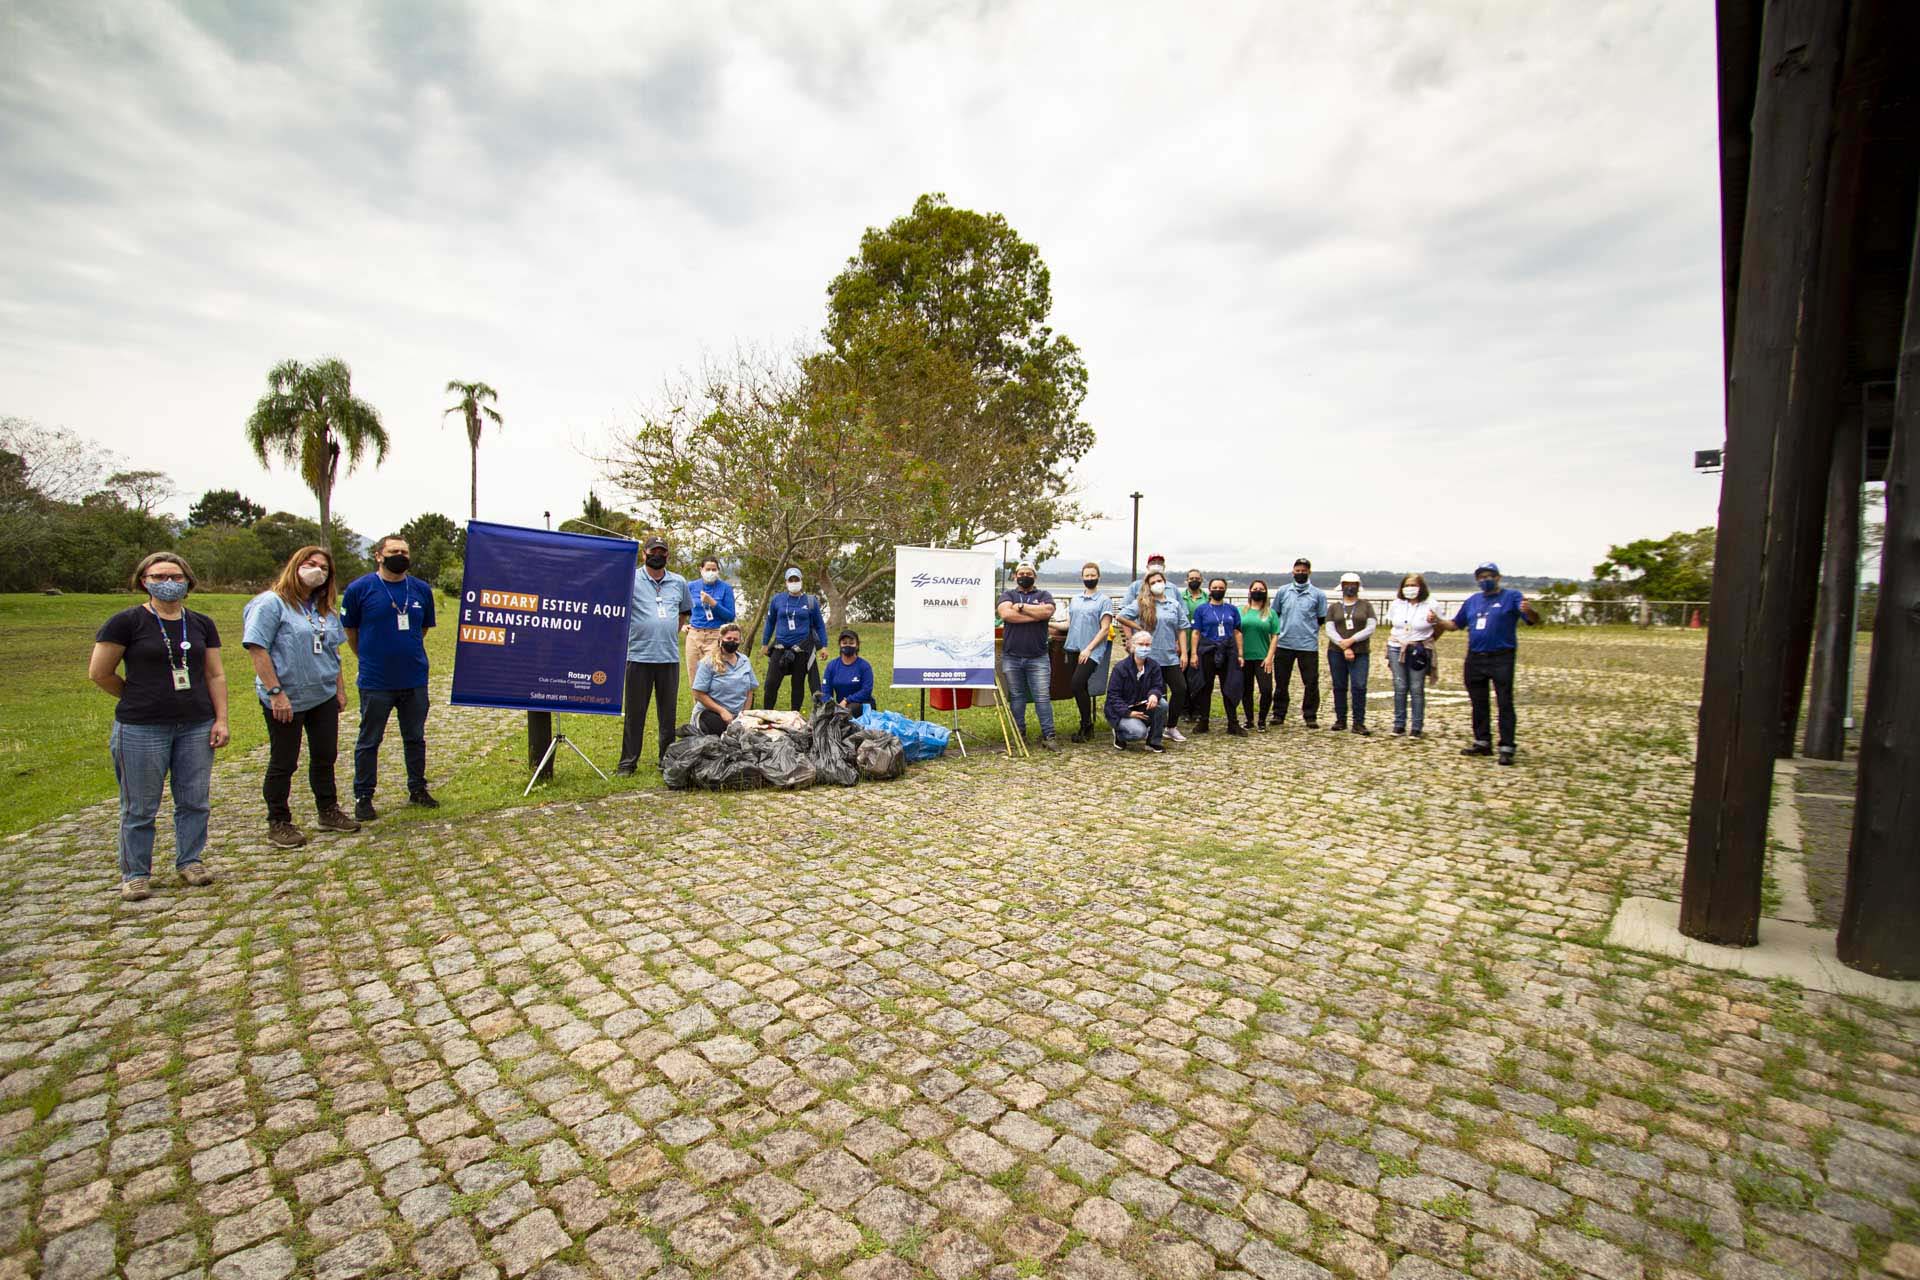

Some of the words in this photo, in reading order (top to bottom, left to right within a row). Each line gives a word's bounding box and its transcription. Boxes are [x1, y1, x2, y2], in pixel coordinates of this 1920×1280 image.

[932, 577, 981, 586] SANEPAR
[466, 591, 476, 603] O
[482, 592, 537, 609] ROTARY
[542, 598, 588, 614] ESTEVE
[593, 604, 626, 618] AQUI
[923, 599, 960, 607] PARANÁ
[464, 609, 472, 621] E
[478, 610, 582, 631] TRANSFORMOU
[462, 627, 505, 643] VIDAS
[510, 632, 516, 644] !
[568, 671, 592, 681] Rotary
[530, 691, 545, 699] Saiba
